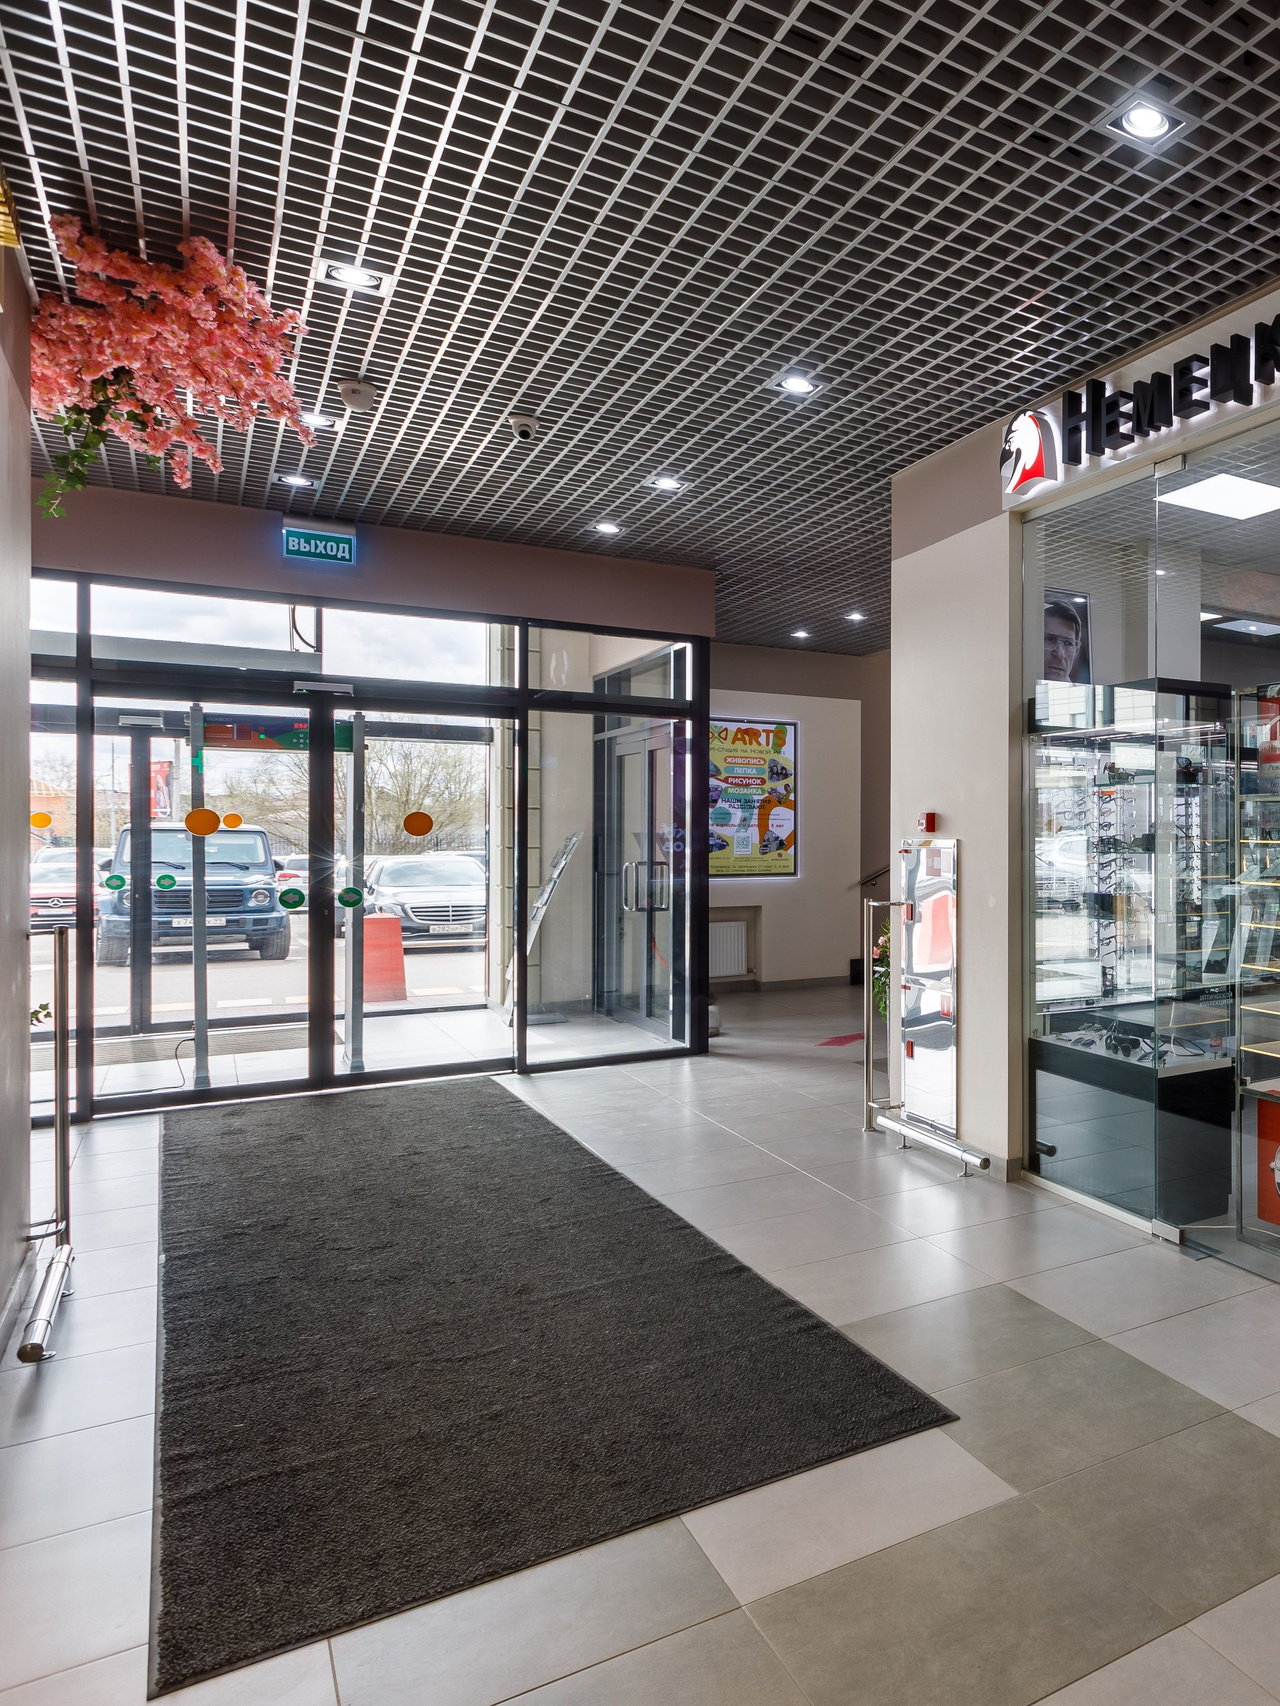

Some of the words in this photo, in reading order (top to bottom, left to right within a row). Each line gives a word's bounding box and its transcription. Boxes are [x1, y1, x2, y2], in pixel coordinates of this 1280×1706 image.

[288, 536, 350, 560] ВЫХОД
[731, 727, 786, 747] ARTS
[726, 757, 765, 765] ЖИВОПИСЬ
[733, 766, 757, 774] ЛЕПКА
[728, 777, 762, 785] РИСУНОК
[727, 787, 762, 796] МОЗАИКА
